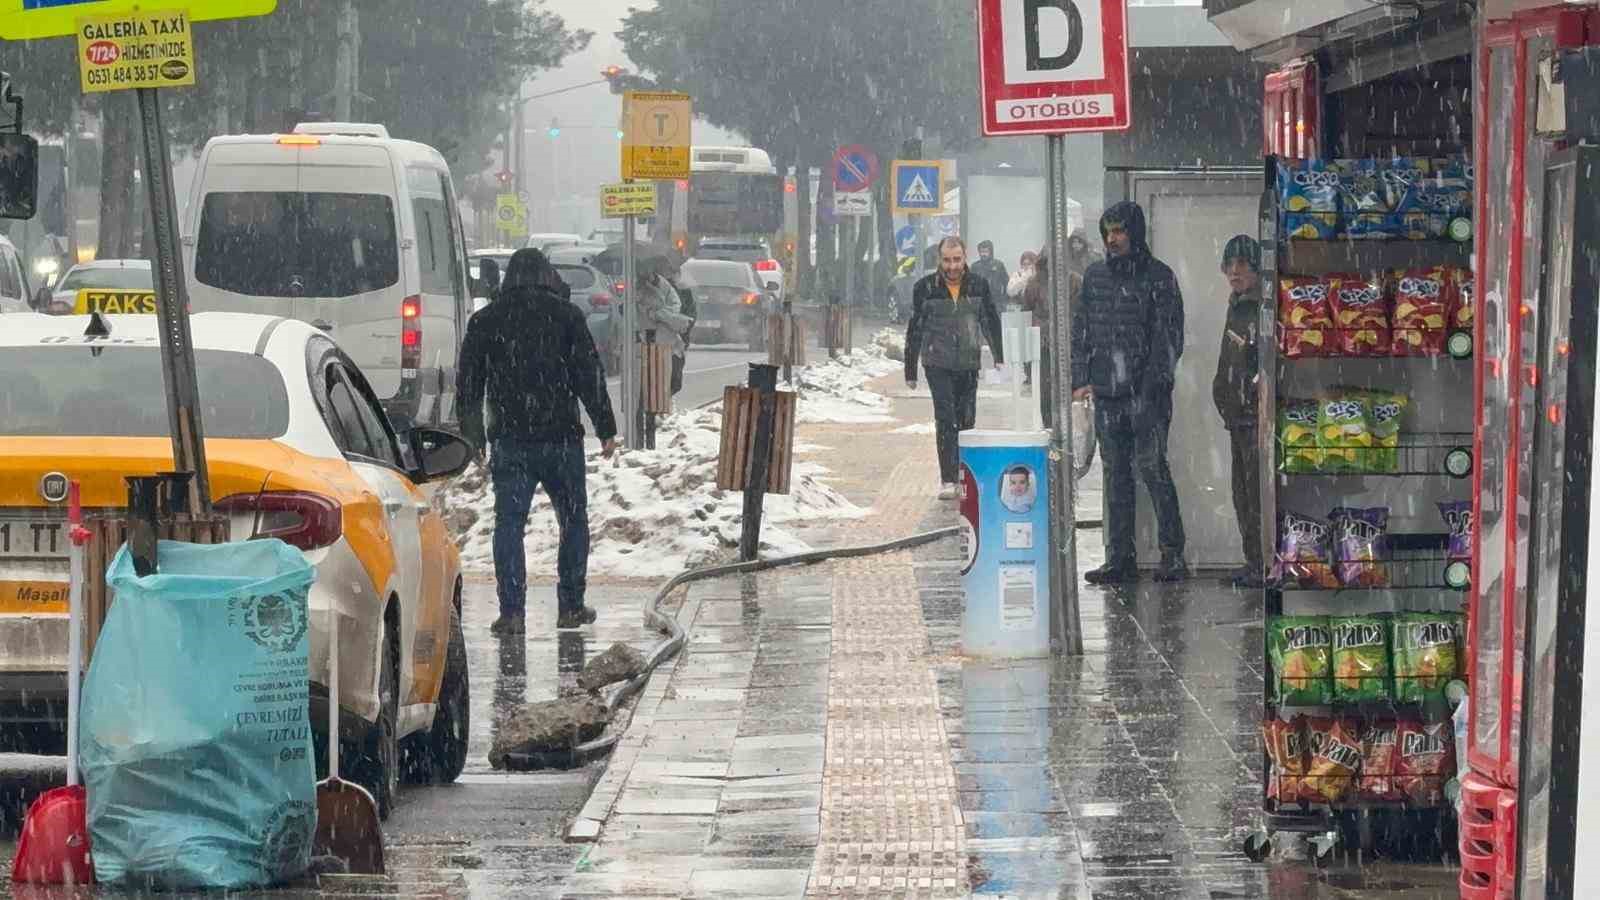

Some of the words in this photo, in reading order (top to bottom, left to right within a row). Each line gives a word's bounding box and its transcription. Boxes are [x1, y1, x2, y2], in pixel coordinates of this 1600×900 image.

[83, 17, 147, 40] GALERİA
[151, 13, 185, 35] TAXİ
[1023, 0, 1083, 71] D
[87, 68, 111, 84] 0531
[113, 66, 131, 82] 484
[147, 64, 159, 80] 57
[1010, 99, 1101, 119] OTOBÜS
[654, 112, 669, 136] T
[30, 523, 61, 552] TT
